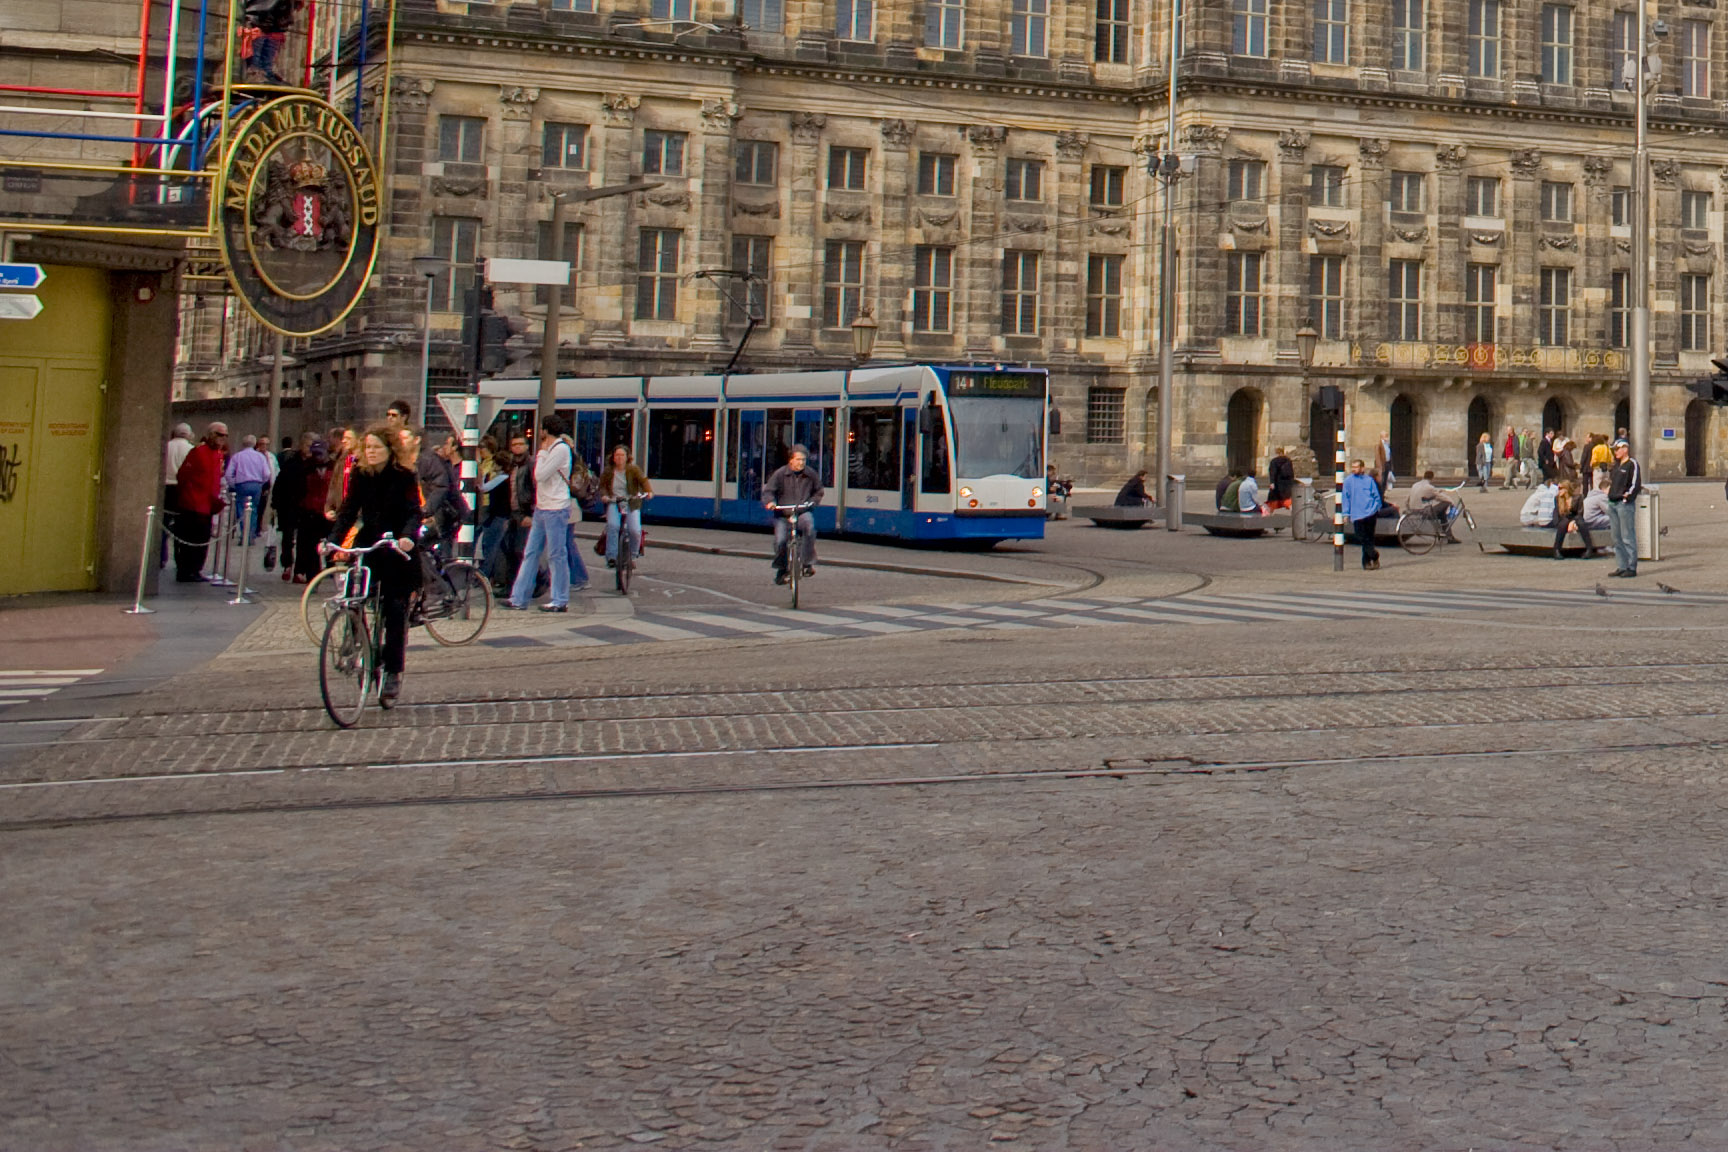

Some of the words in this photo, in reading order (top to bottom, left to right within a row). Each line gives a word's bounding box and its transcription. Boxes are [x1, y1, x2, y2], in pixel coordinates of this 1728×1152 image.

[226, 104, 311, 210] MADAME
[317, 107, 377, 226] TUSSAUD
[954, 376, 967, 390] 14
